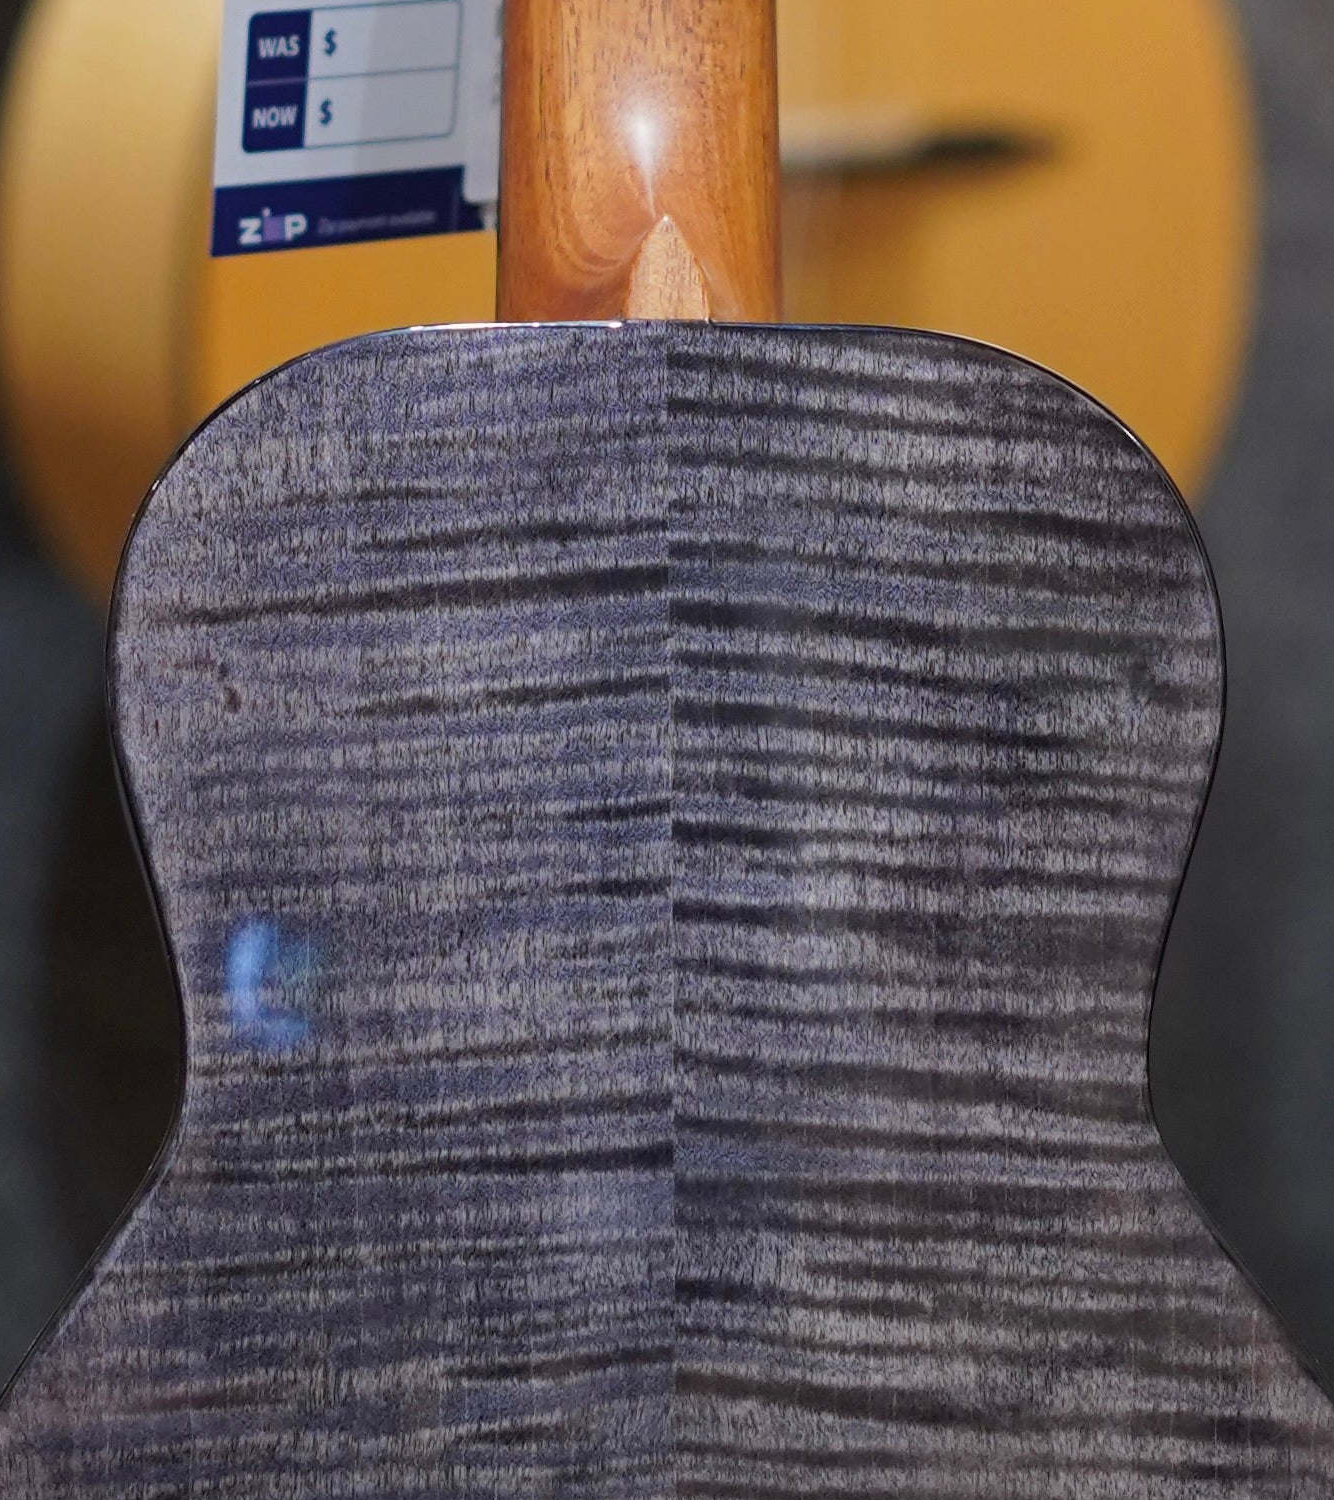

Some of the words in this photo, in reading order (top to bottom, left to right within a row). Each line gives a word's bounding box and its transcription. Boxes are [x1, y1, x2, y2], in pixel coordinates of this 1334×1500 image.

[258, 36, 300, 60] WAS
[323, 28, 338, 57] $
[252, 105, 299, 129] NOW
[319, 98, 334, 127] $
